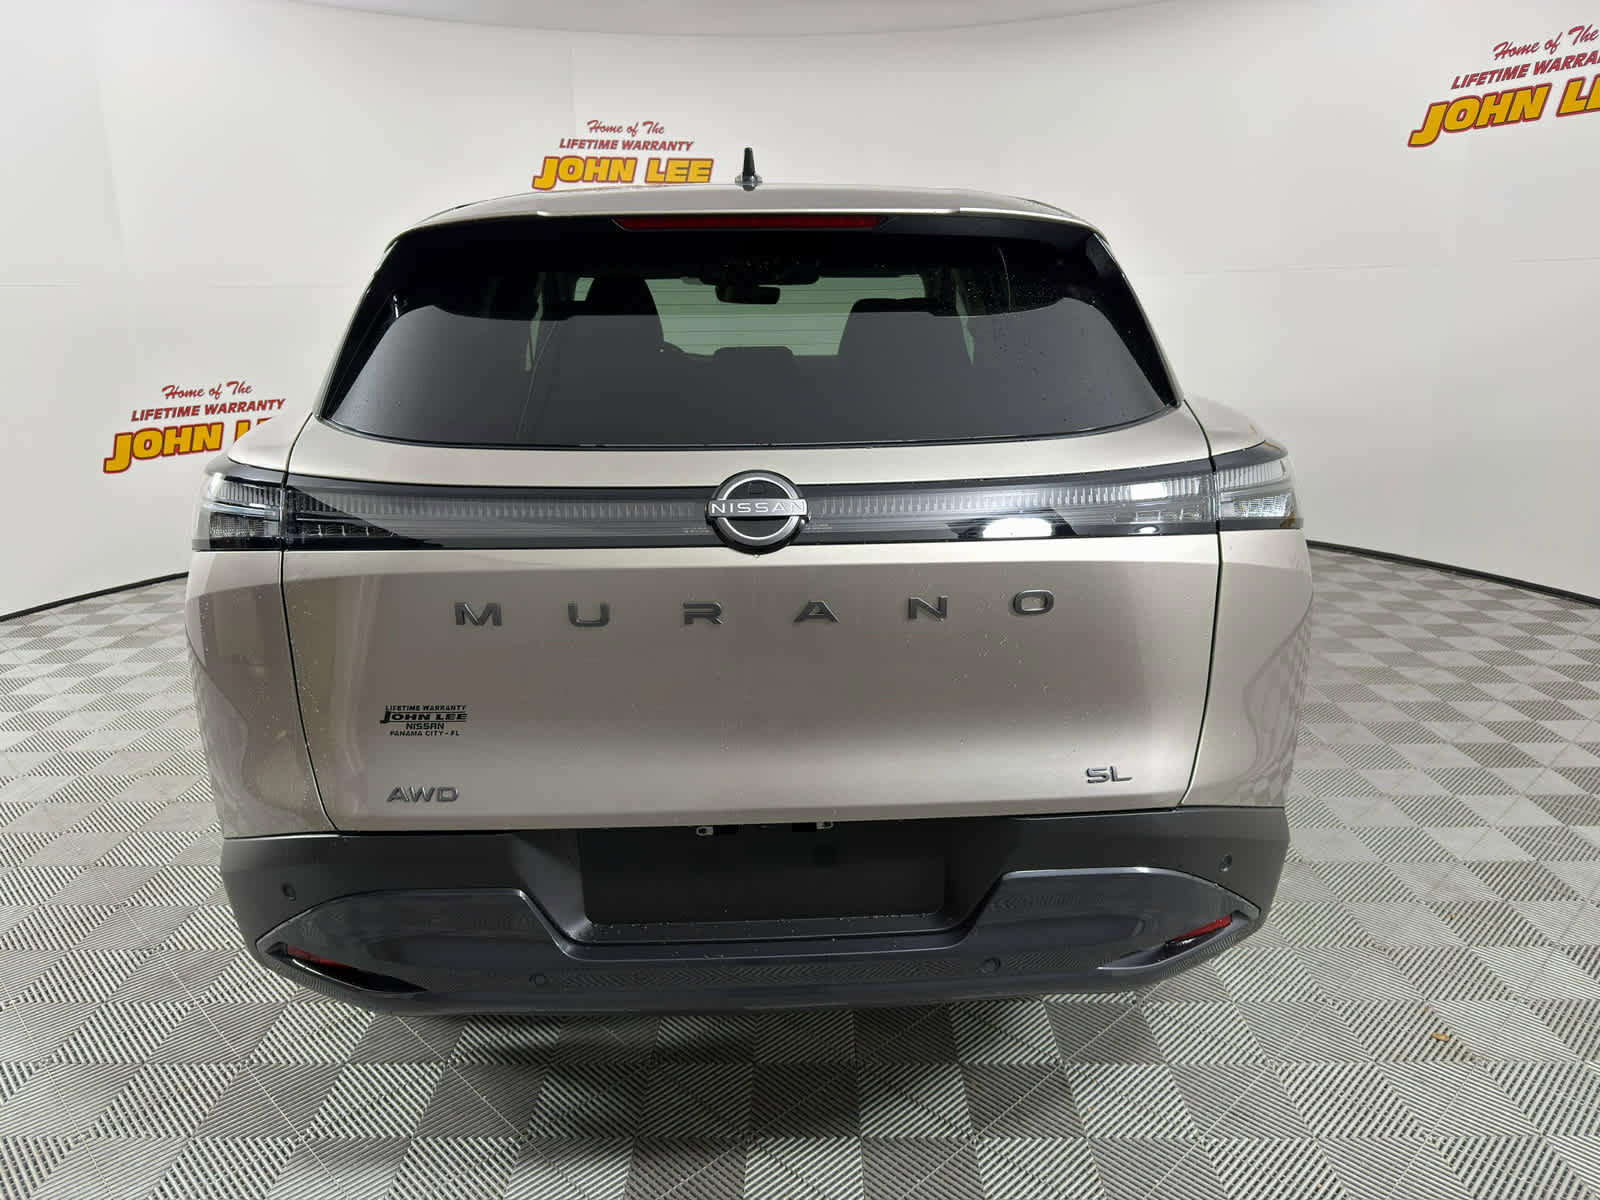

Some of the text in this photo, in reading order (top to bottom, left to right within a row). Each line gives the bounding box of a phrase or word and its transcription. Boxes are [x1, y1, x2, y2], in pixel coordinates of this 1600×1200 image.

[1492, 24, 1599, 60] Home of The
[1450, 50, 1600, 89] LIFETIME WARRA
[1407, 82, 1552, 147] JOHN
[586, 119, 665, 137] Home of The
[559, 138, 694, 152] LIFETIME WARRANTY
[532, 156, 714, 190] JOHN LEE
[161, 381, 252, 400] Home of The
[131, 398, 286, 422] LIFETIME WARRANTY
[103, 421, 224, 474] JOHN
[711, 502, 804, 515] NISSAN
[454, 588, 1055, 628] MURANO
[379, 711, 469, 724] JOHN LEE
[385, 704, 421, 712] LIFETIME
[1085, 766, 1133, 783] SL
[386, 786, 460, 803] AWD
